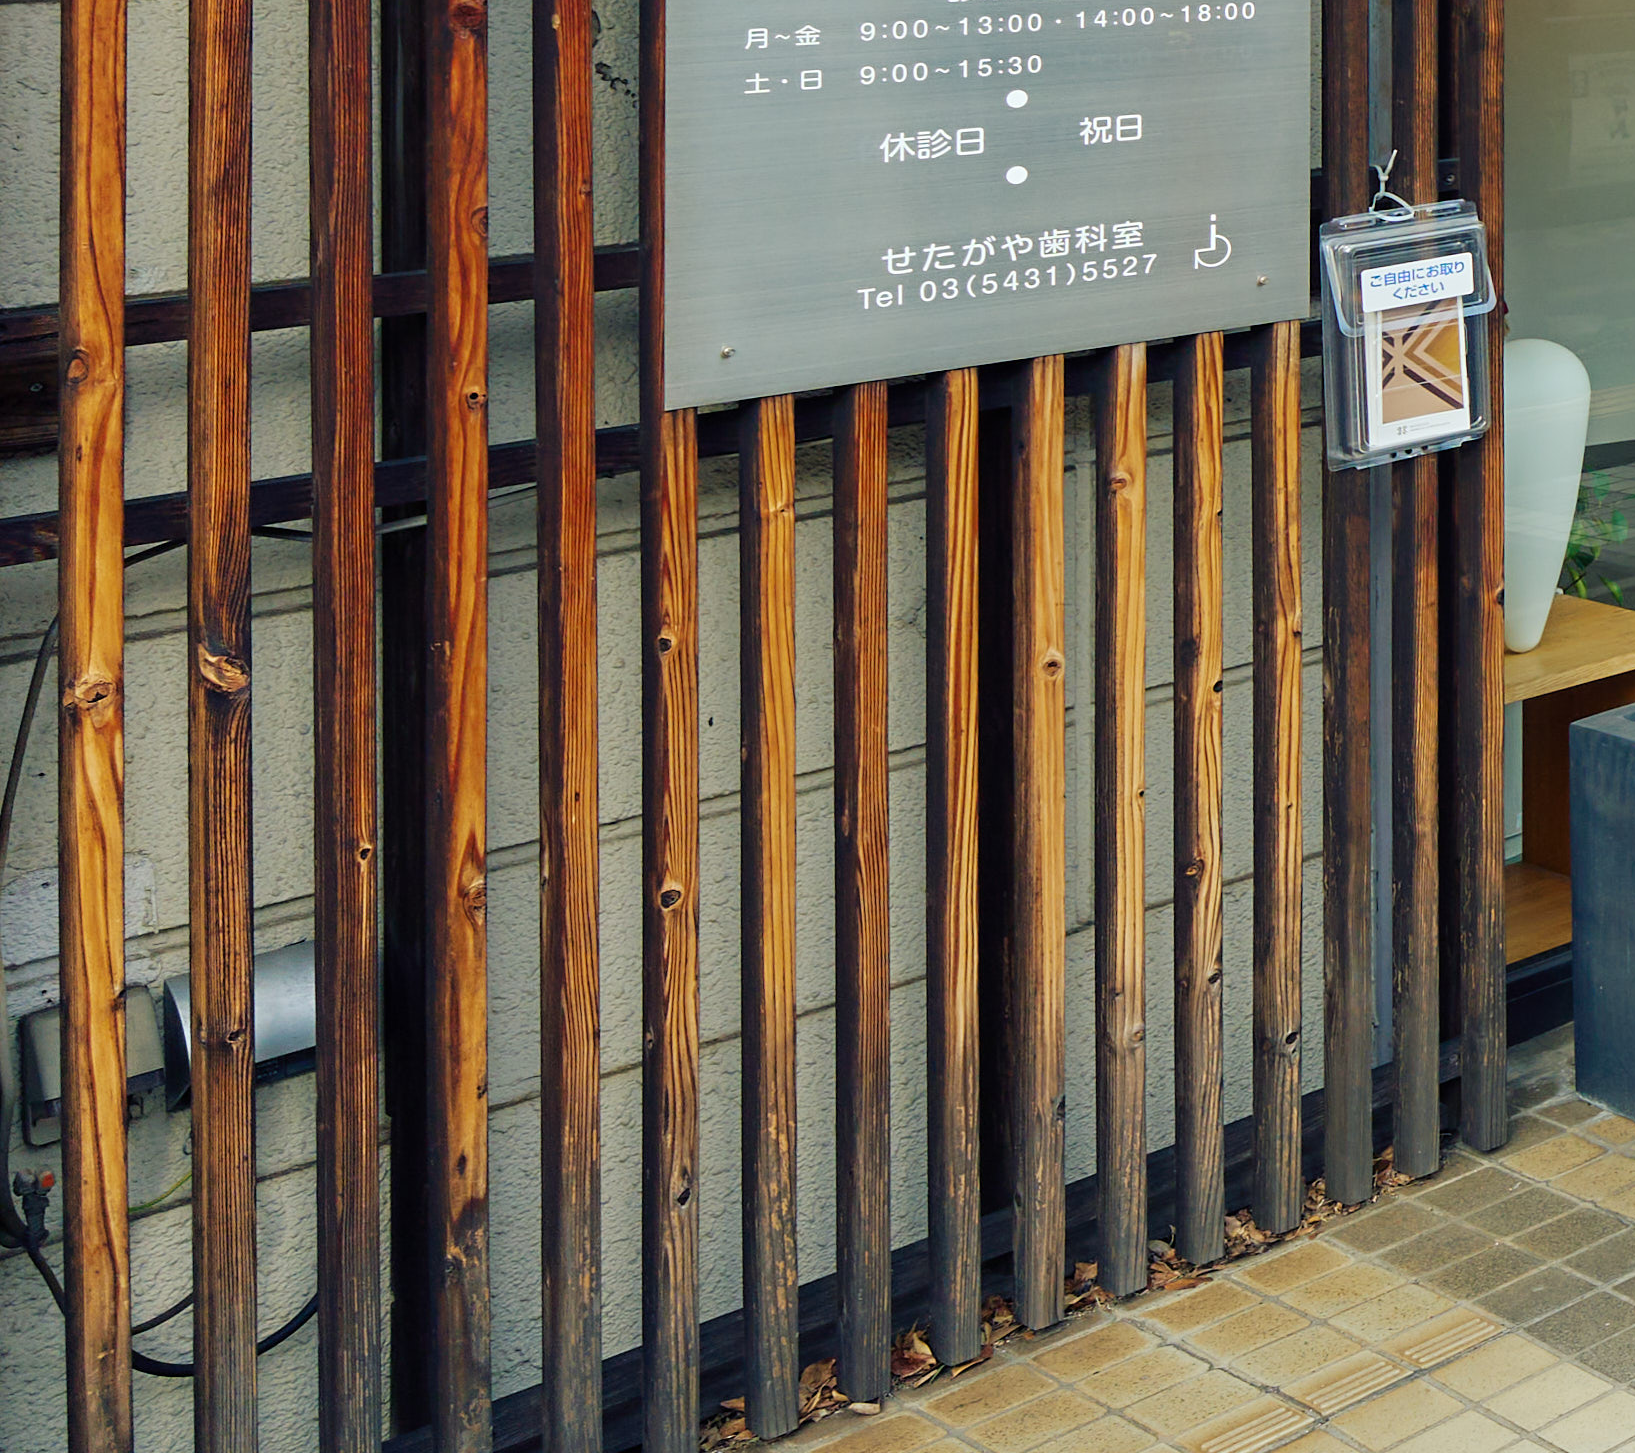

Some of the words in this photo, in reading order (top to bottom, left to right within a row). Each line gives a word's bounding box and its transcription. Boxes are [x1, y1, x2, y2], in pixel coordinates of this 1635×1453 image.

[879, 126, 987, 163] 休診日
[1078, 113, 1145, 145] 祝日
[880, 219, 1146, 276] せたがや歯科室
[857, 286, 906, 311] Tel
[919, 252, 1160, 303] 03(5431)5527
[1369, 259, 1466, 289] ご自由にお取り
[1391, 280, 1445, 301] ください
